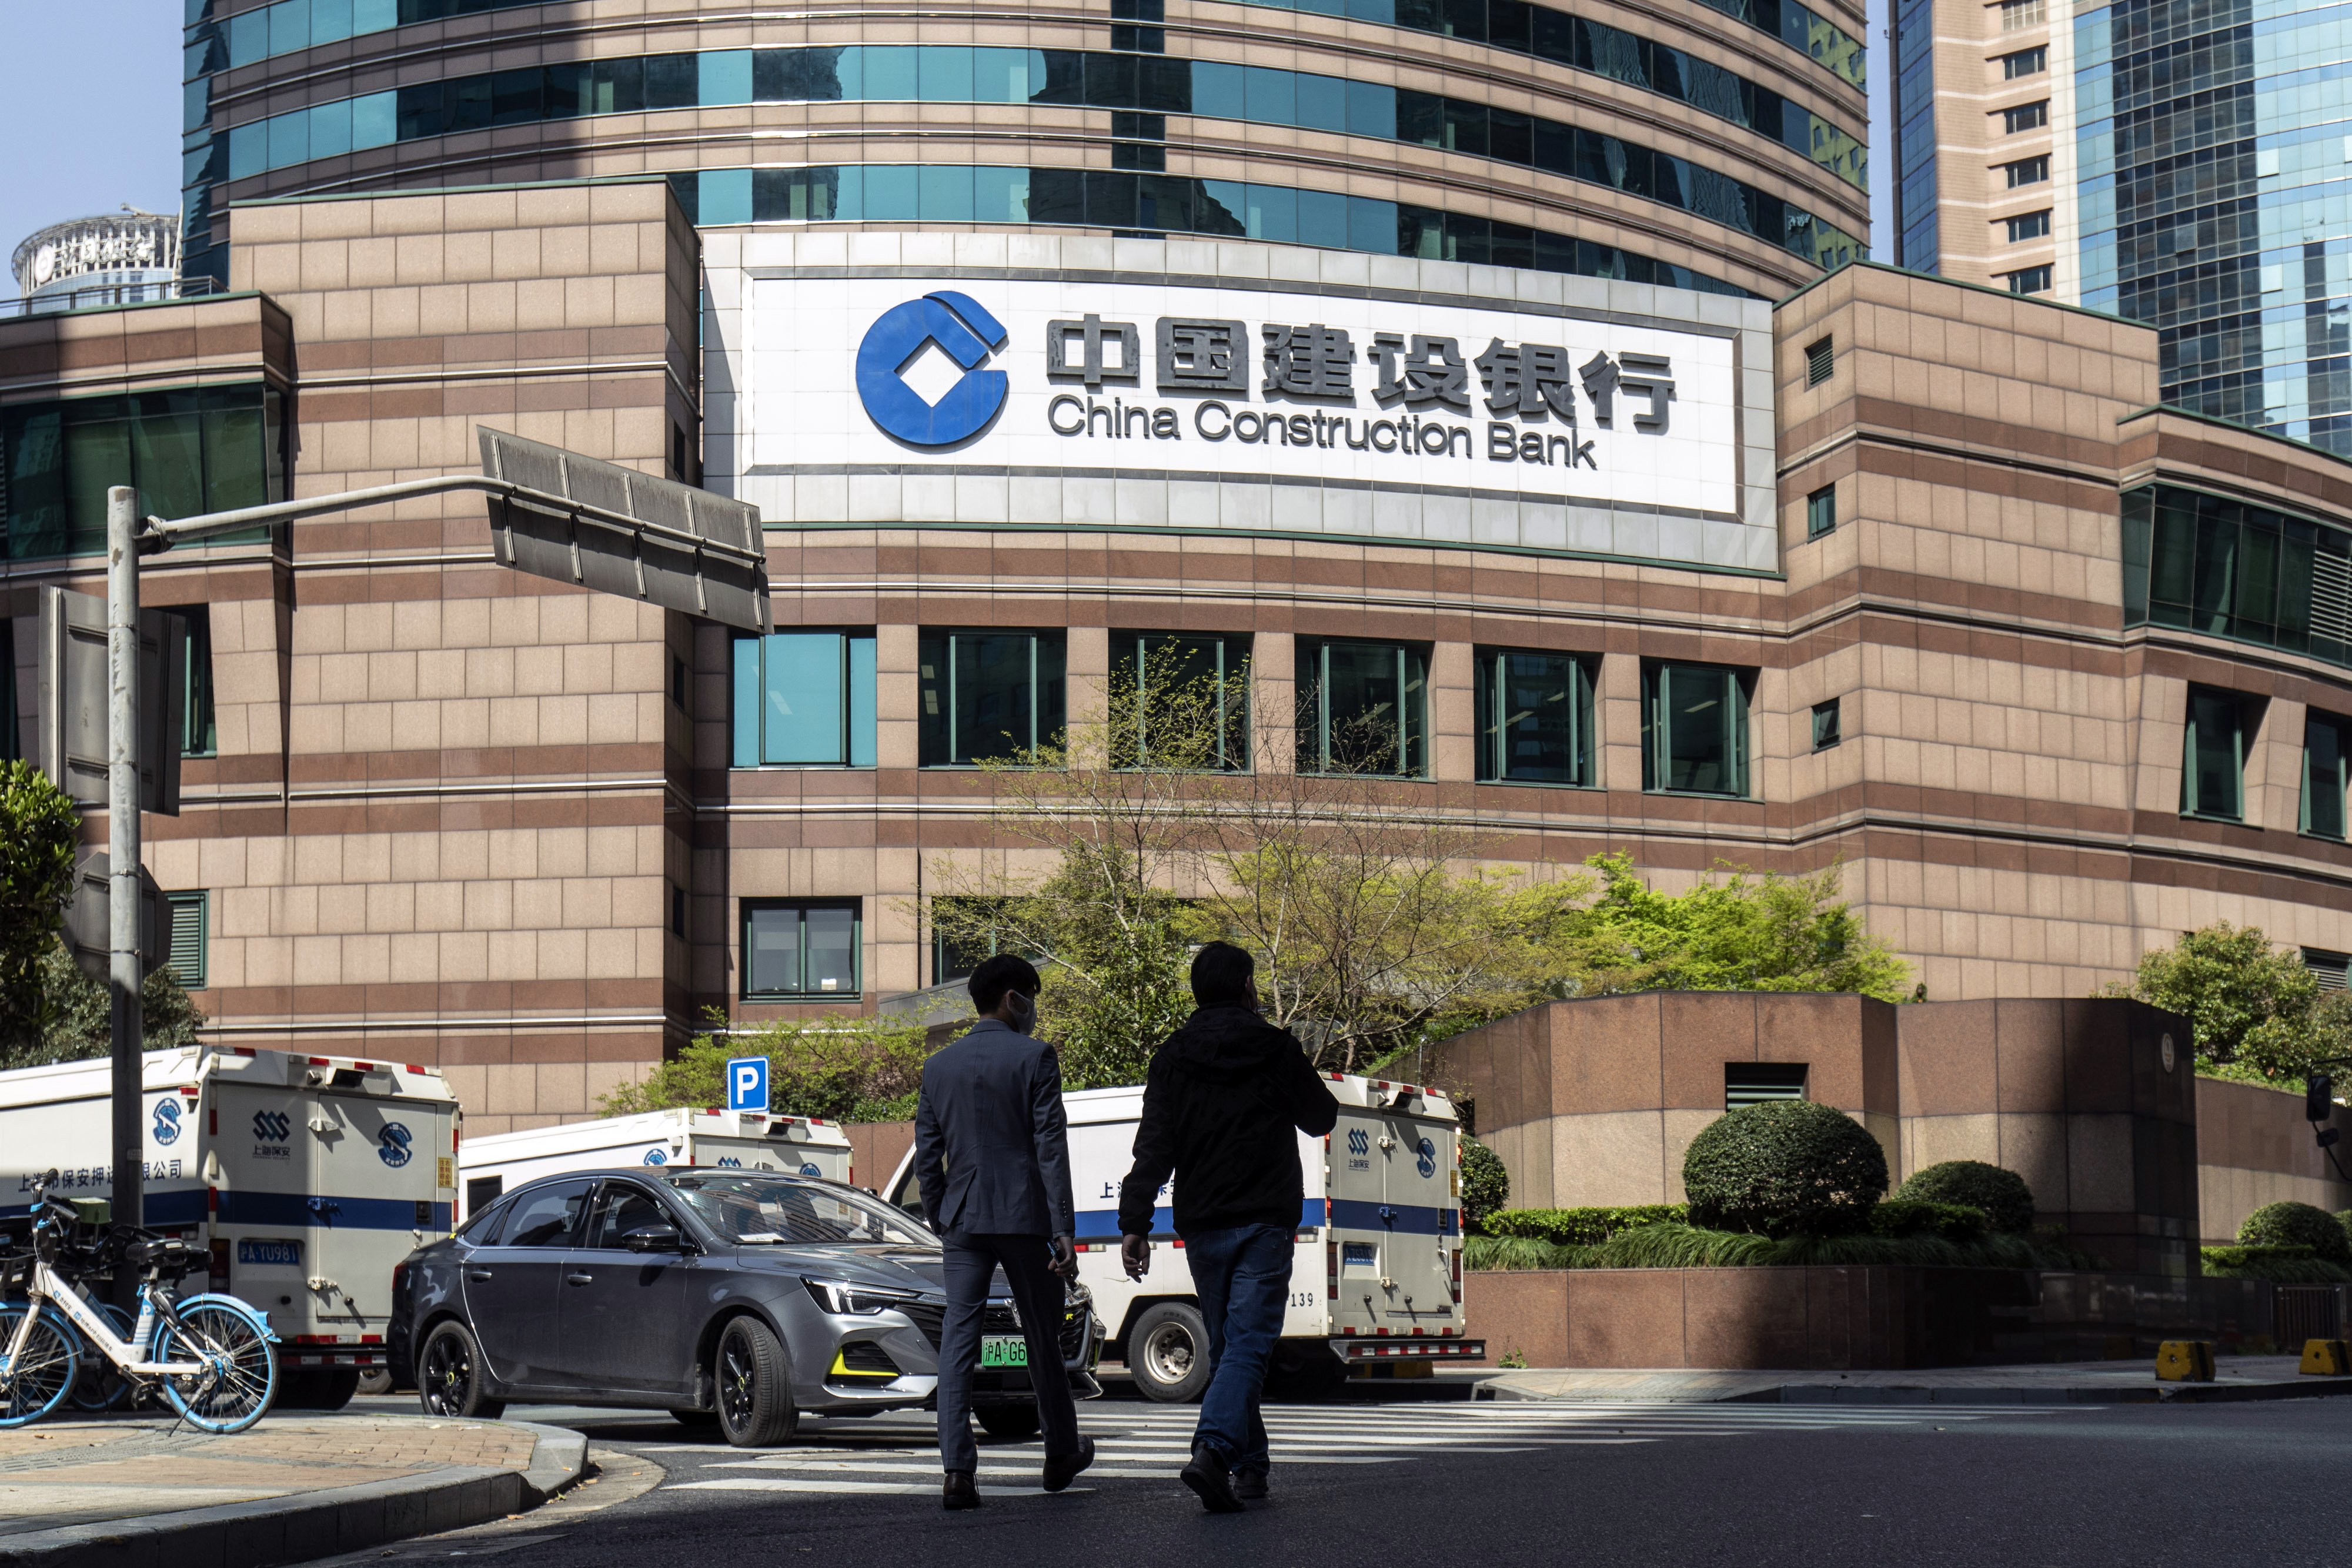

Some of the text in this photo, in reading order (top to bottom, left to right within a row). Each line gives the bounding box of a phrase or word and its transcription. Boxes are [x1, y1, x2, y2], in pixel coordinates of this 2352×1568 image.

[1047, 315, 1676, 429] 中国建设银行
[1047, 394, 1597, 470] China Construction Bank
[737, 1066, 759, 1104] P
[253, 1145, 290, 1157] 上海保安
[1348, 1158, 1369, 1169] 上海保安
[1291, 1293, 1313, 1307] 139
